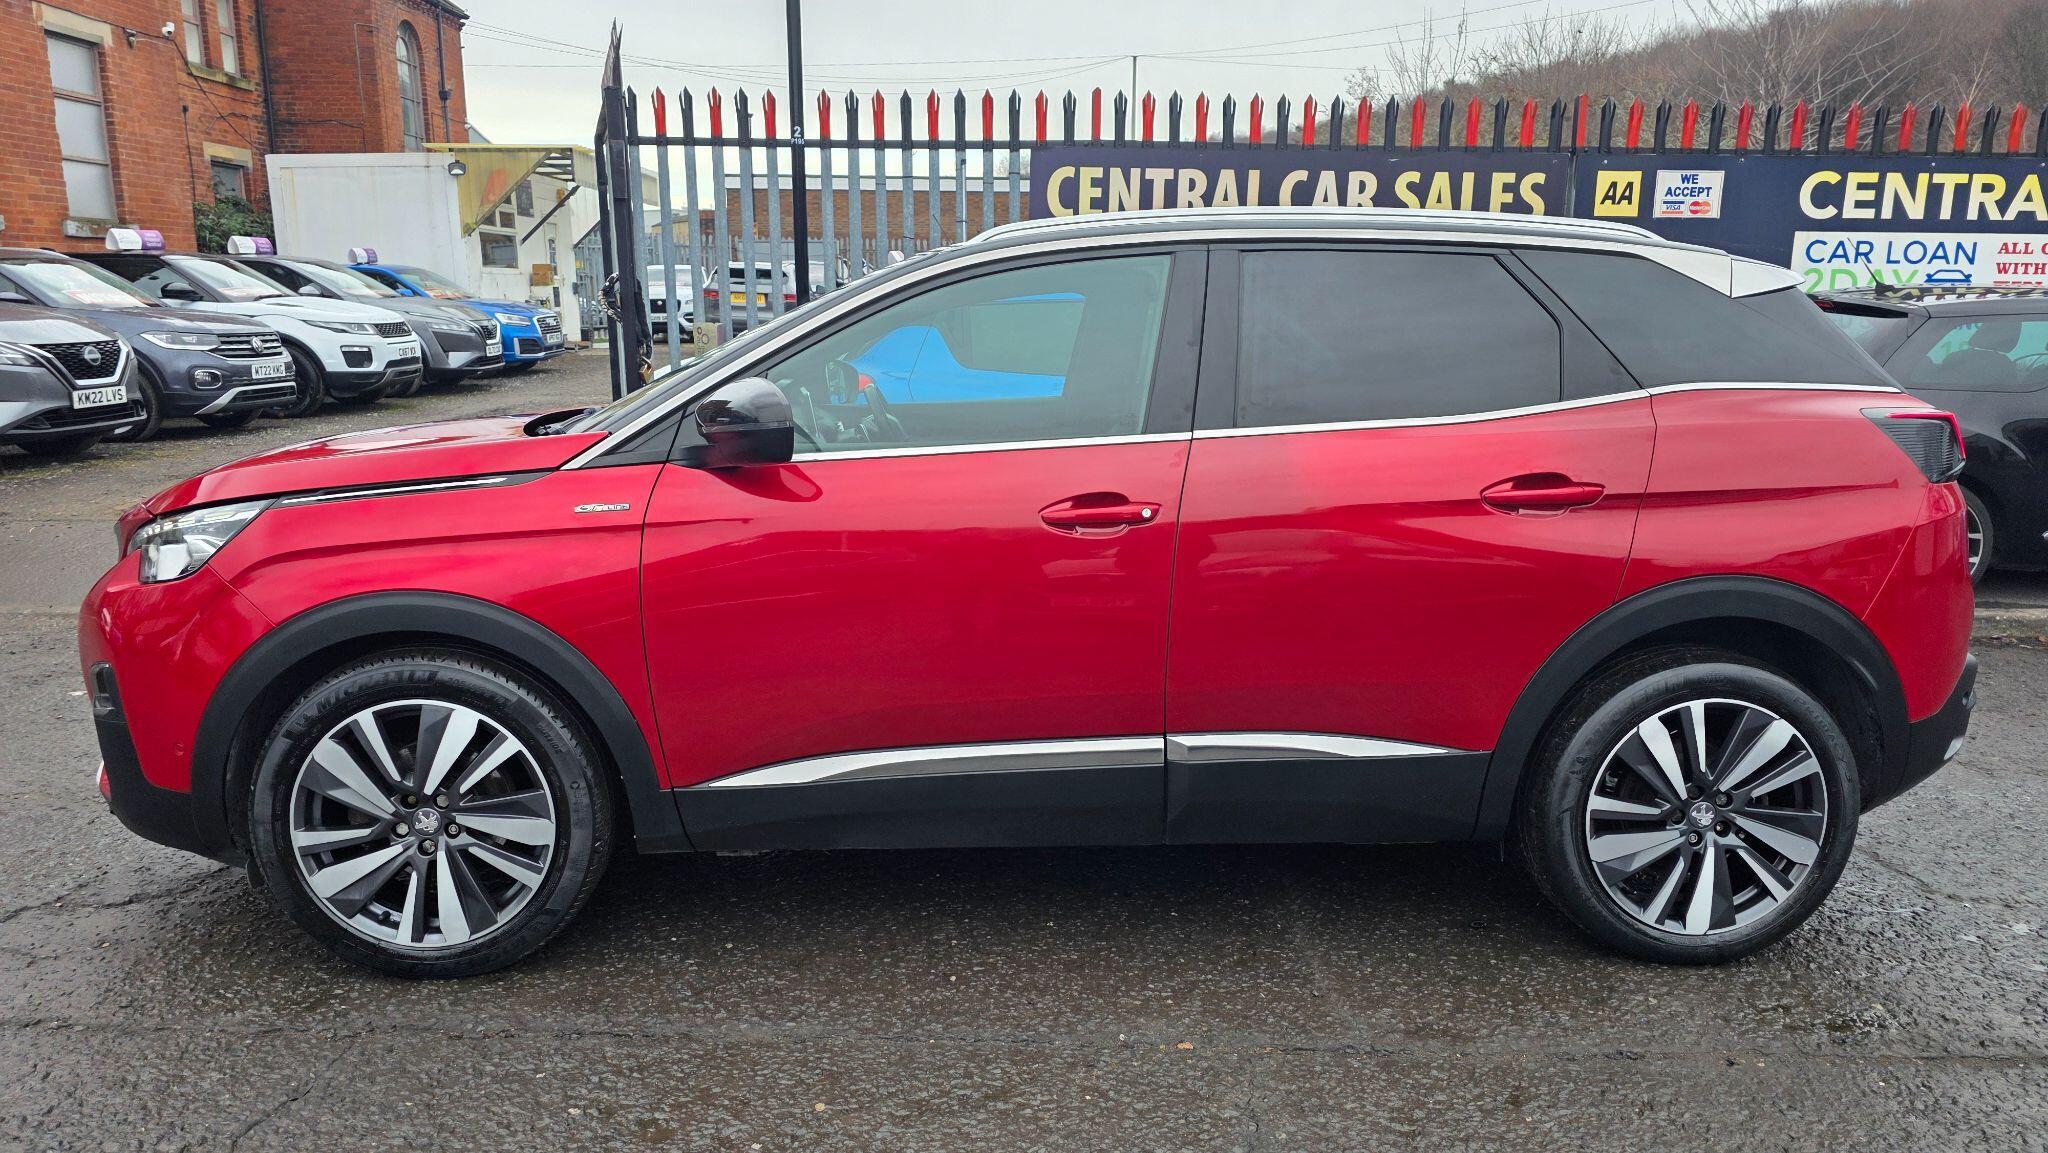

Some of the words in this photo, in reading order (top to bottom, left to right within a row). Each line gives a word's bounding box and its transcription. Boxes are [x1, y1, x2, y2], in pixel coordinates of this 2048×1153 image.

[793, 126, 802, 138] 2
[1680, 173, 1700, 185] WE
[1046, 166, 1261, 218] CENTRAL
[1278, 170, 1378, 208] CAR
[1394, 171, 1547, 216] SALES
[1599, 181, 1635, 206] AA
[1664, 186, 1713, 198] ACCEPT
[1799, 170, 2048, 222] CENTRA
[1804, 239, 1875, 264] CAR
[1885, 240, 1978, 265] LOAN
[1997, 242, 2034, 255] ALL
[77, 391, 104, 406] KM22
[105, 387, 124, 402] LVS
